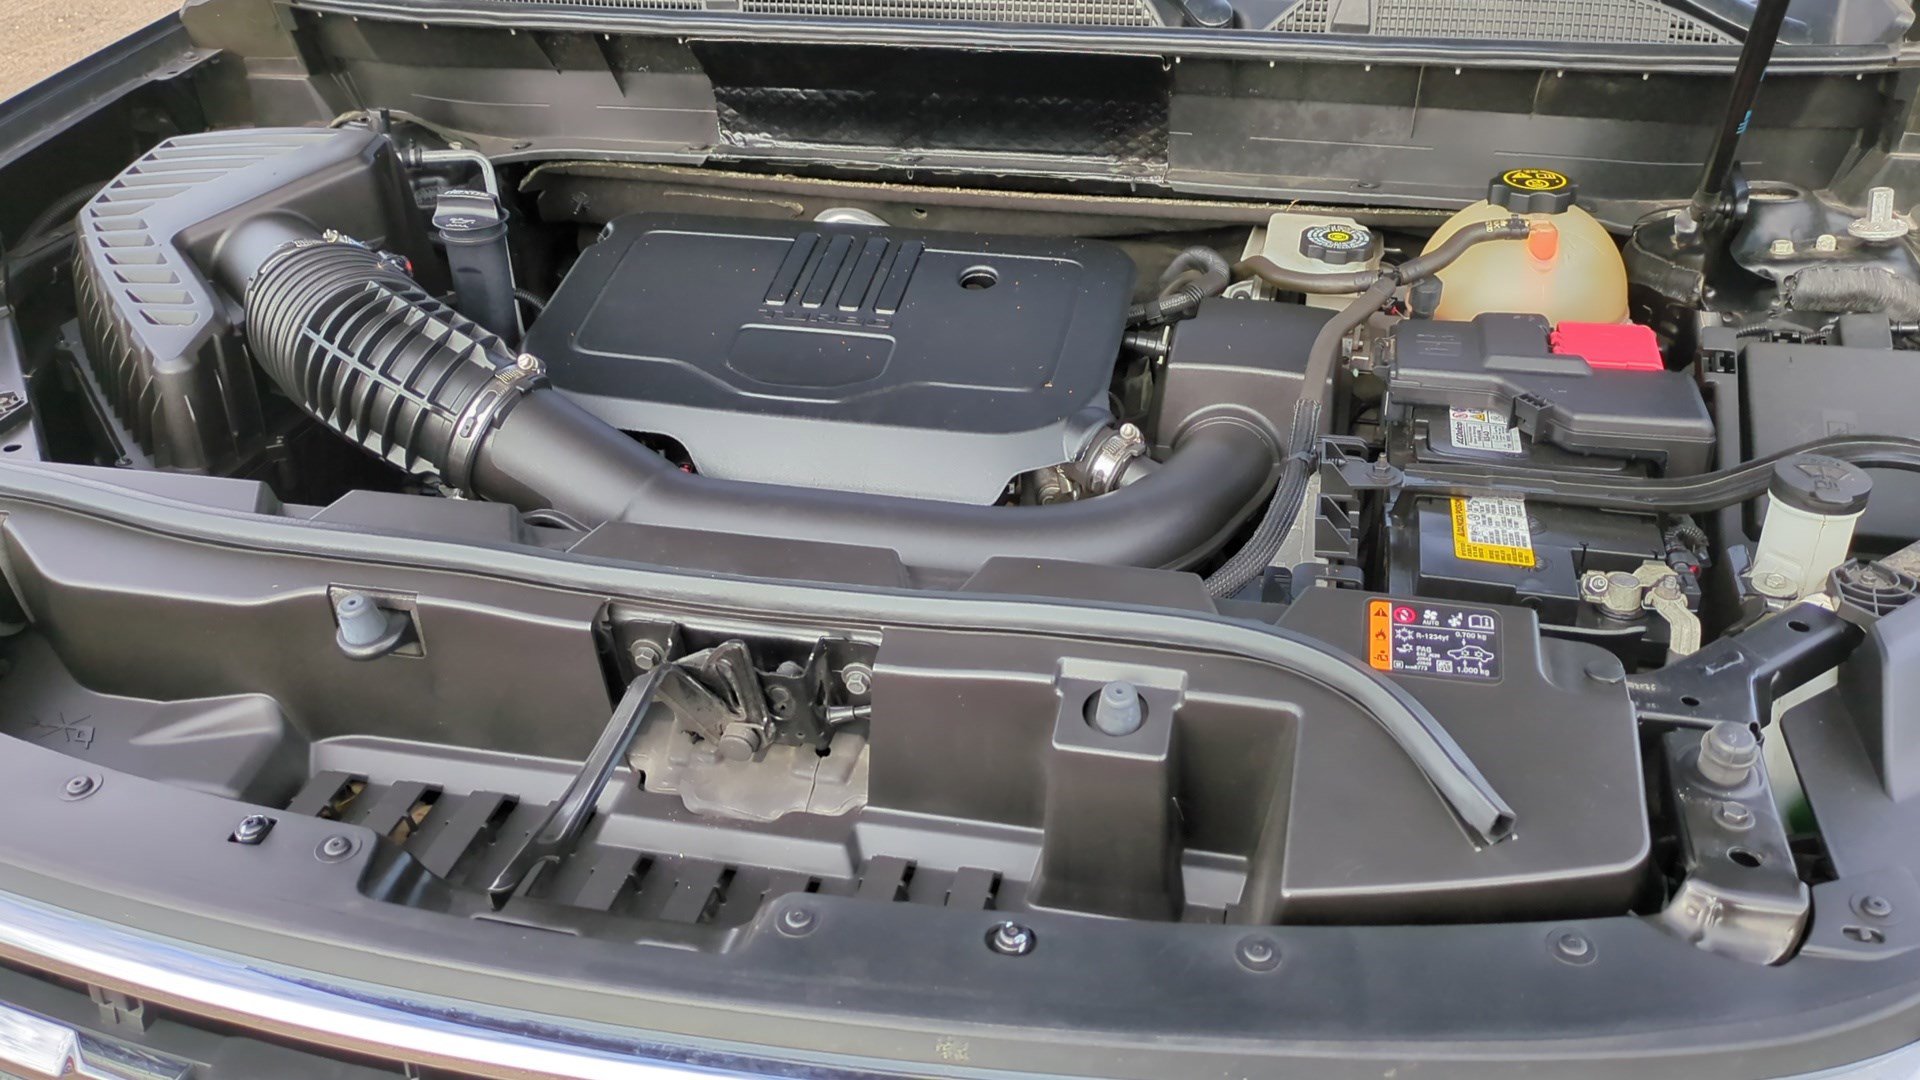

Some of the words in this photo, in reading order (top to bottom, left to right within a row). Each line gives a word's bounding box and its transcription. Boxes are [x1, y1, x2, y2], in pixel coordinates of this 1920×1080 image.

[758, 308, 892, 329] TURBO
[1416, 633, 1449, 642] R-1234yf
[1455, 631, 1476, 639] 0.700
[1477, 632, 1487, 641] kg
[1457, 665, 1479, 675] 1.000
